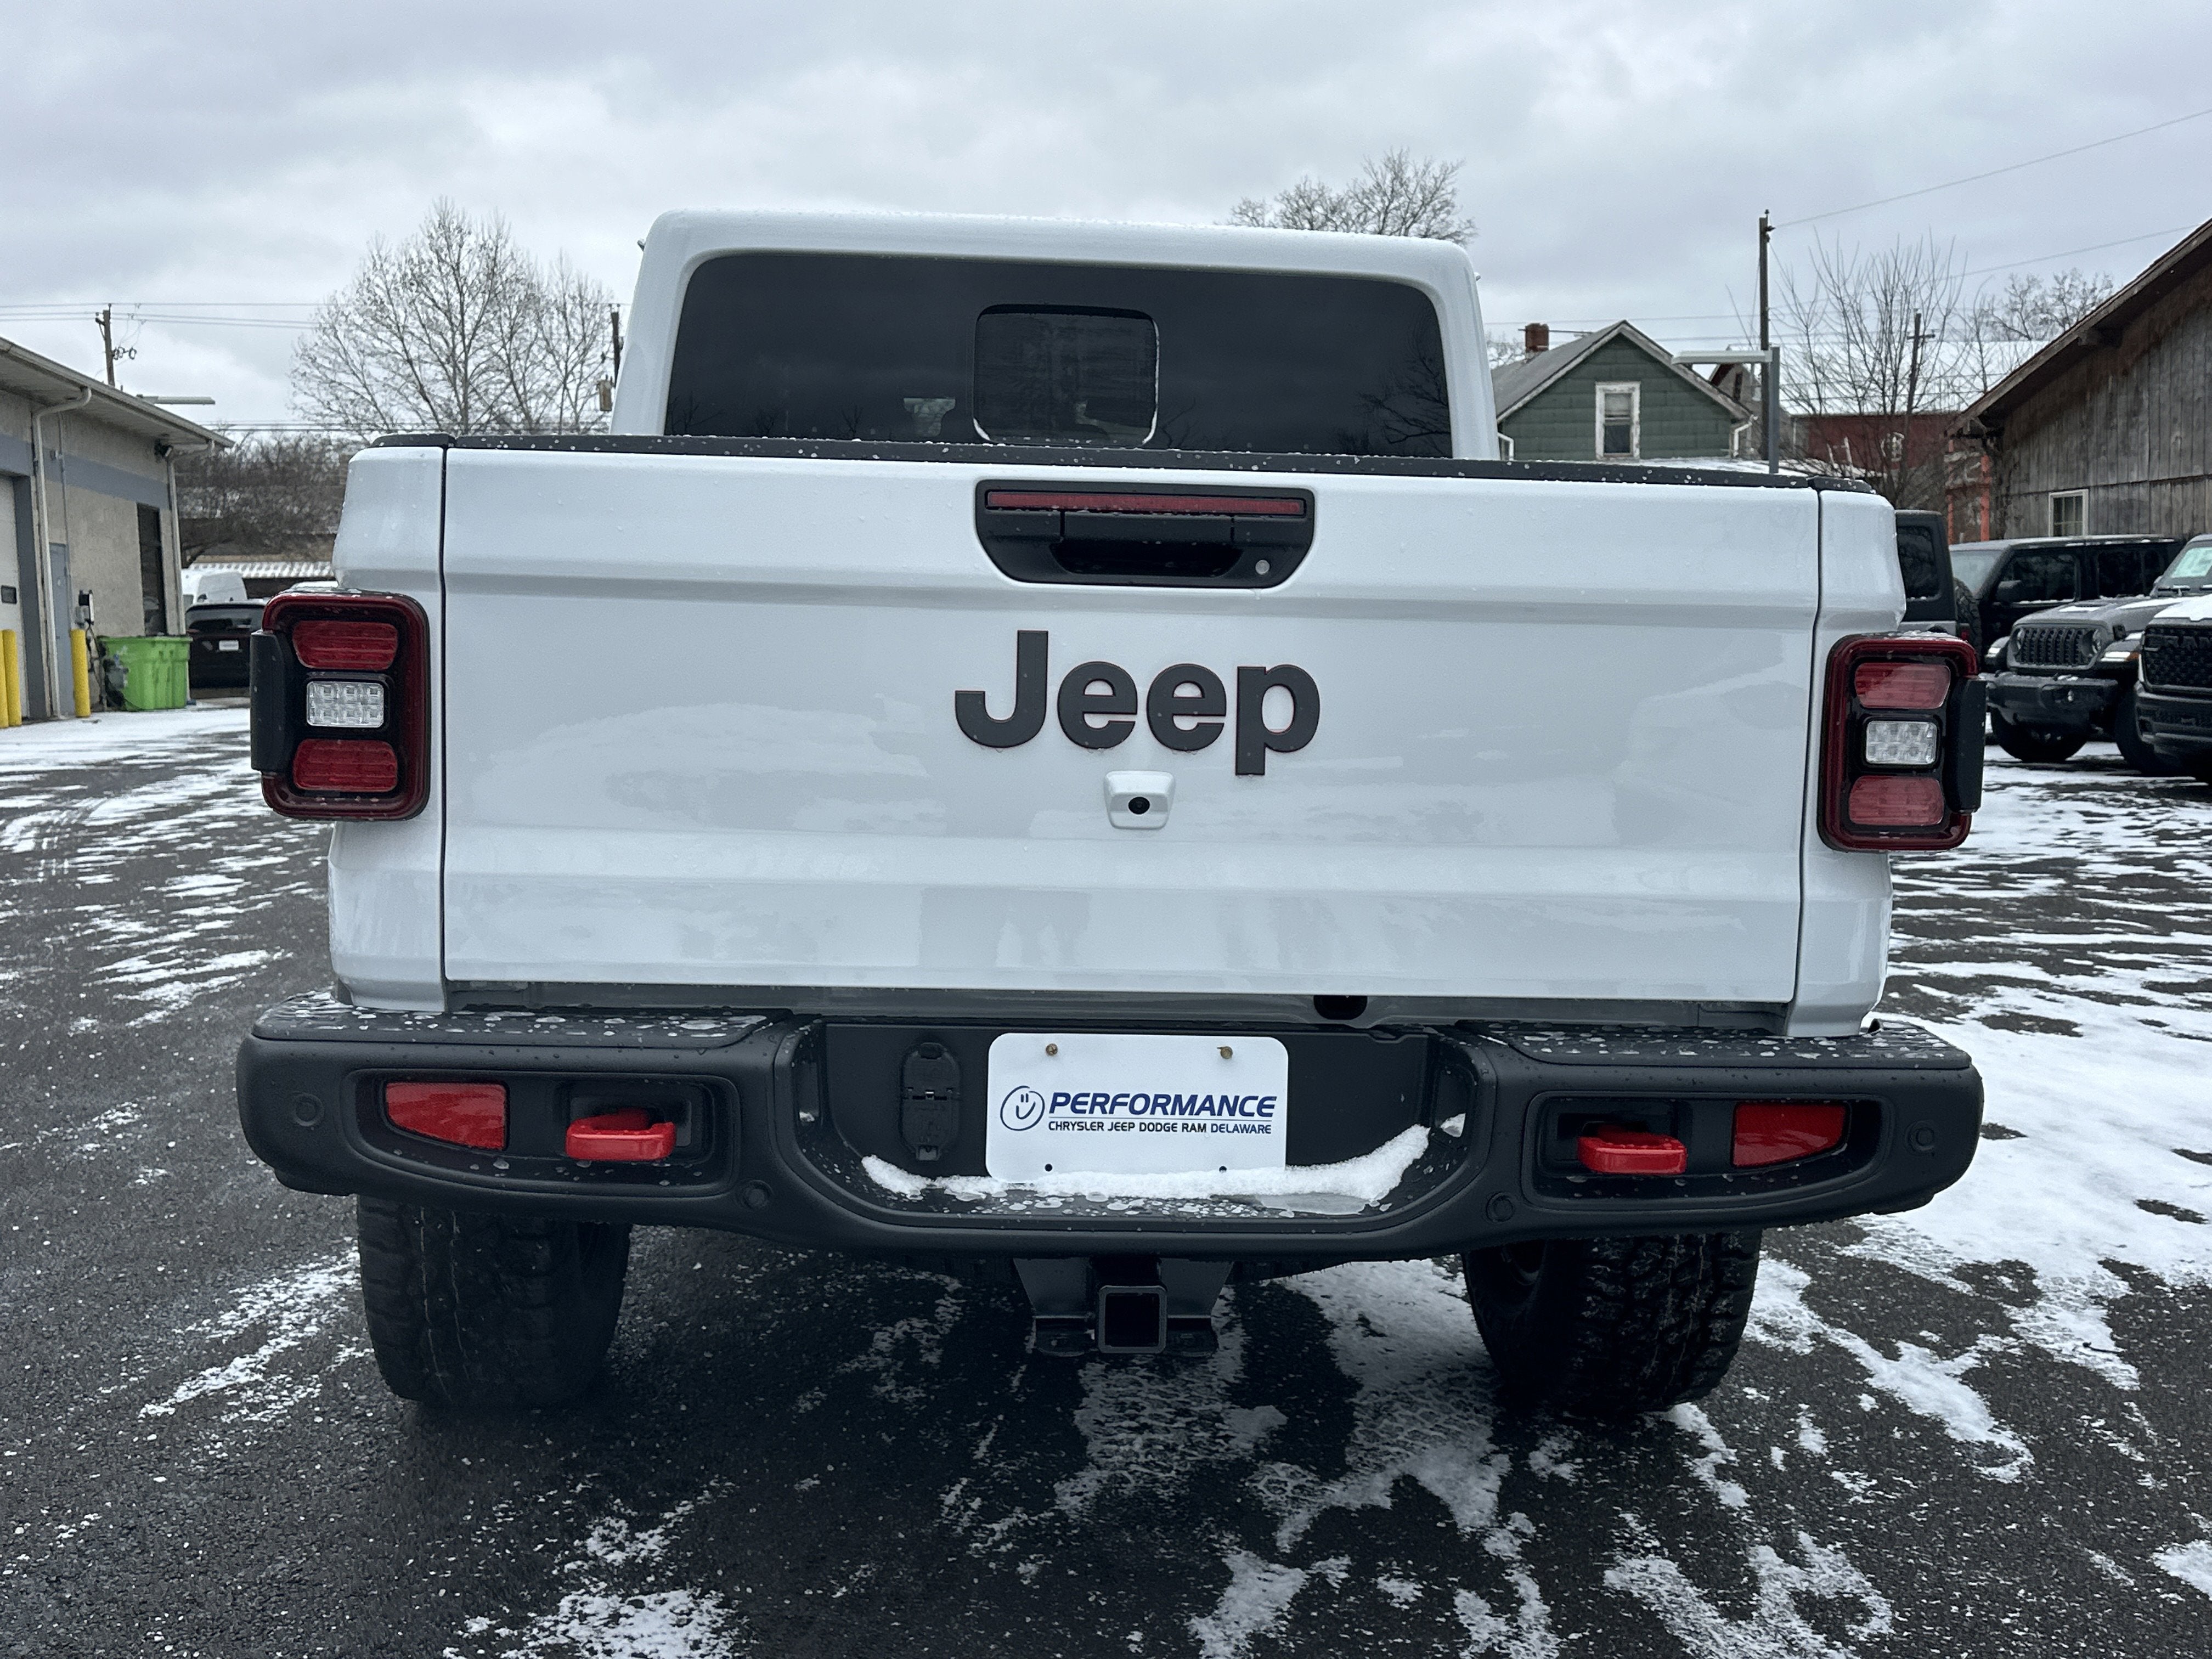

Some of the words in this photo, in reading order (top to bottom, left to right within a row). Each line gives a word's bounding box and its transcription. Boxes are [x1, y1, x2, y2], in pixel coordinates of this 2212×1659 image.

[955, 630, 1320, 775] Jeep
[1048, 1092, 1277, 1118] PERFORMANCE
[1048, 1121, 1104, 1131] CHRYSLER
[1107, 1121, 1135, 1132] JEEP
[1138, 1122, 1178, 1132] DODGE
[1182, 1122, 1207, 1133] RAM
[1210, 1123, 1272, 1134] DELAWARE
